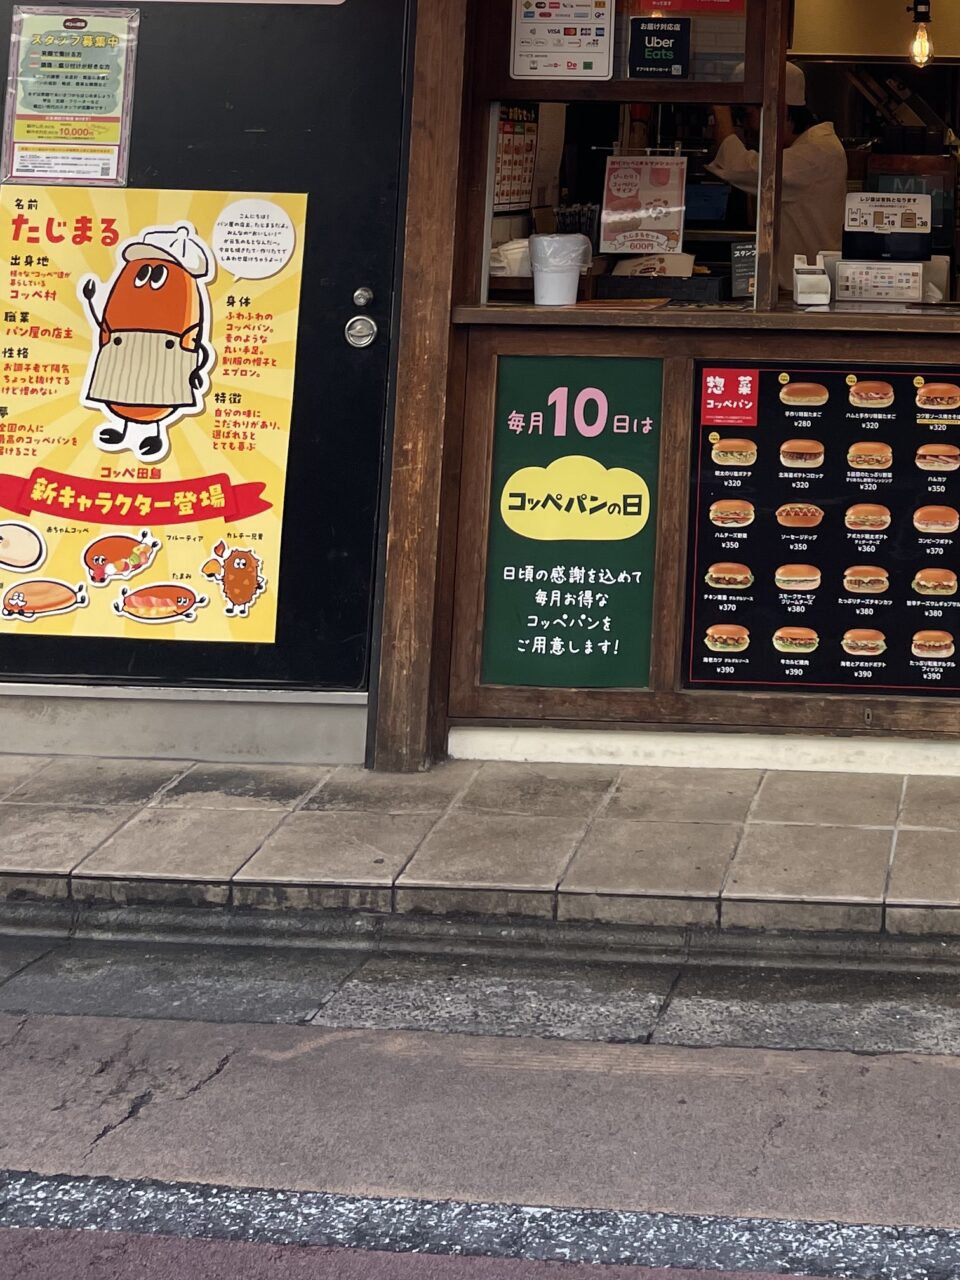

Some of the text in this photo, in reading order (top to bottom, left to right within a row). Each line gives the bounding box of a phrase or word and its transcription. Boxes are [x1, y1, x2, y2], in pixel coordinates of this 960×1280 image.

[640, 23, 681, 31] お届け対応店
[31, 33, 119, 48] スタッフ募集中
[645, 36, 675, 48] Uber
[644, 48, 674, 59] Eats
[15, 198, 38, 210] 名前
[11, 213, 120, 247] たじまる
[10, 255, 49, 267] 出身地
[10, 290, 57, 301] コッペ村
[226, 295, 252, 307] 身体
[4, 311, 30, 323] 職業
[225, 312, 273, 321] ふわふわの
[6, 326, 73, 339] パン屋の店主
[226, 323, 274, 333] コッペパン。
[2, 347, 29, 358] 性格
[224, 346, 264, 355] 丸い手足。
[222, 357, 277, 367] 制服の帽子と
[222, 369, 261, 378] エプロン。
[214, 392, 242, 404] 特徴
[706, 400, 753, 409] コッペパン
[214, 408, 261, 418] 自分の味に
[507, 386, 653, 438] 毎月10日は
[213, 420, 281, 430] こだわりがあり、
[793, 420, 812, 428] ¥280
[861, 421, 879, 429] ¥320
[212, 430, 256, 440] 選ばれると
[212, 441, 256, 452] とても喜ぶ
[100, 467, 162, 480] コッペ田島
[723, 479, 742, 487] ¥320
[791, 481, 810, 489] ¥320
[859, 483, 878, 491] ¥320
[30, 477, 226, 516] 新キャラクター登場
[508, 492, 643, 516] コッペパンの日
[721, 541, 740, 549] ¥350
[926, 547, 944, 555] ¥370
[503, 565, 642, 584] 日頃の感謝を込めて
[535, 589, 609, 608] 毎月お得な
[718, 603, 737, 611] ¥370
[787, 605, 806, 613] ¥380
[855, 607, 874, 615] ¥380
[924, 609, 943, 617] ¥380
[527, 614, 612, 632] コッペパンを
[516, 636, 619, 656] ご用意します!
[716, 666, 735, 674] ¥390
[785, 668, 804, 676] ¥390
[853, 670, 872, 678] ¥390
[922, 672, 941, 680] ¥390
